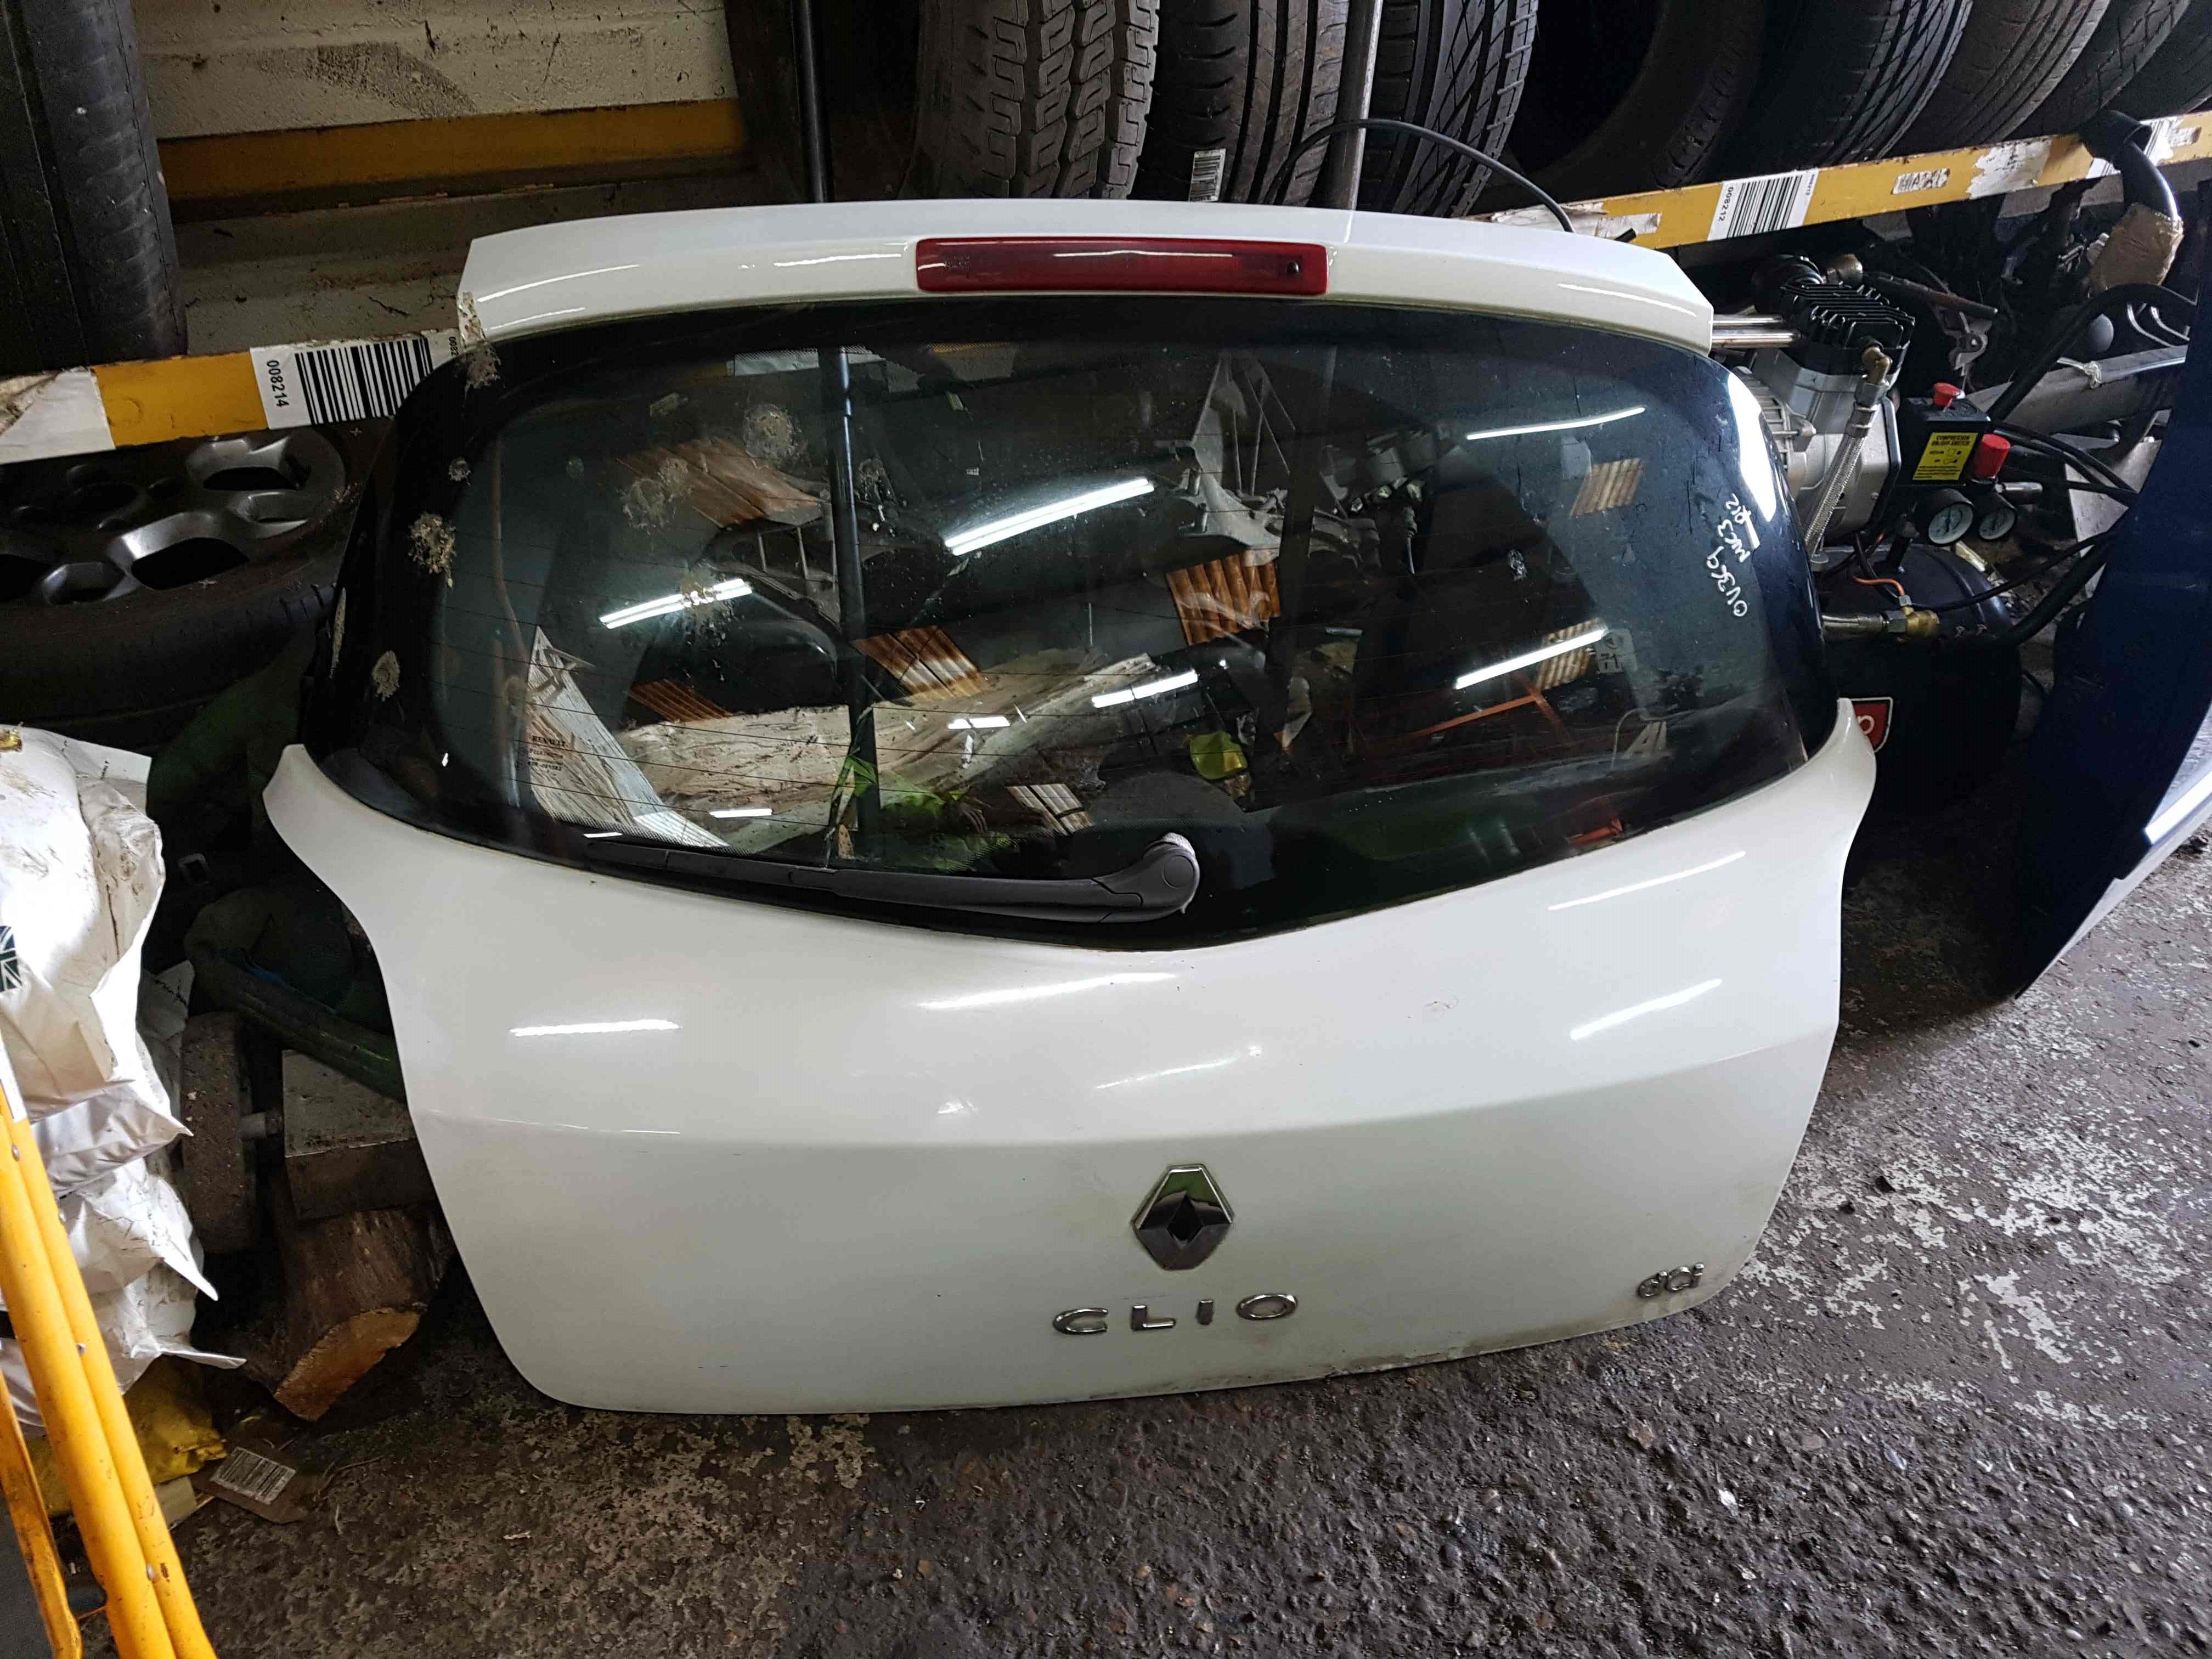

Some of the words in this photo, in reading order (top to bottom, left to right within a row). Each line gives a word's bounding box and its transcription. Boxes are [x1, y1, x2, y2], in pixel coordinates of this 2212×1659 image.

[1719, 186, 1734, 222] 008212
[266, 359, 290, 408] 008214
[1052, 1293, 1299, 1335] CLIO
